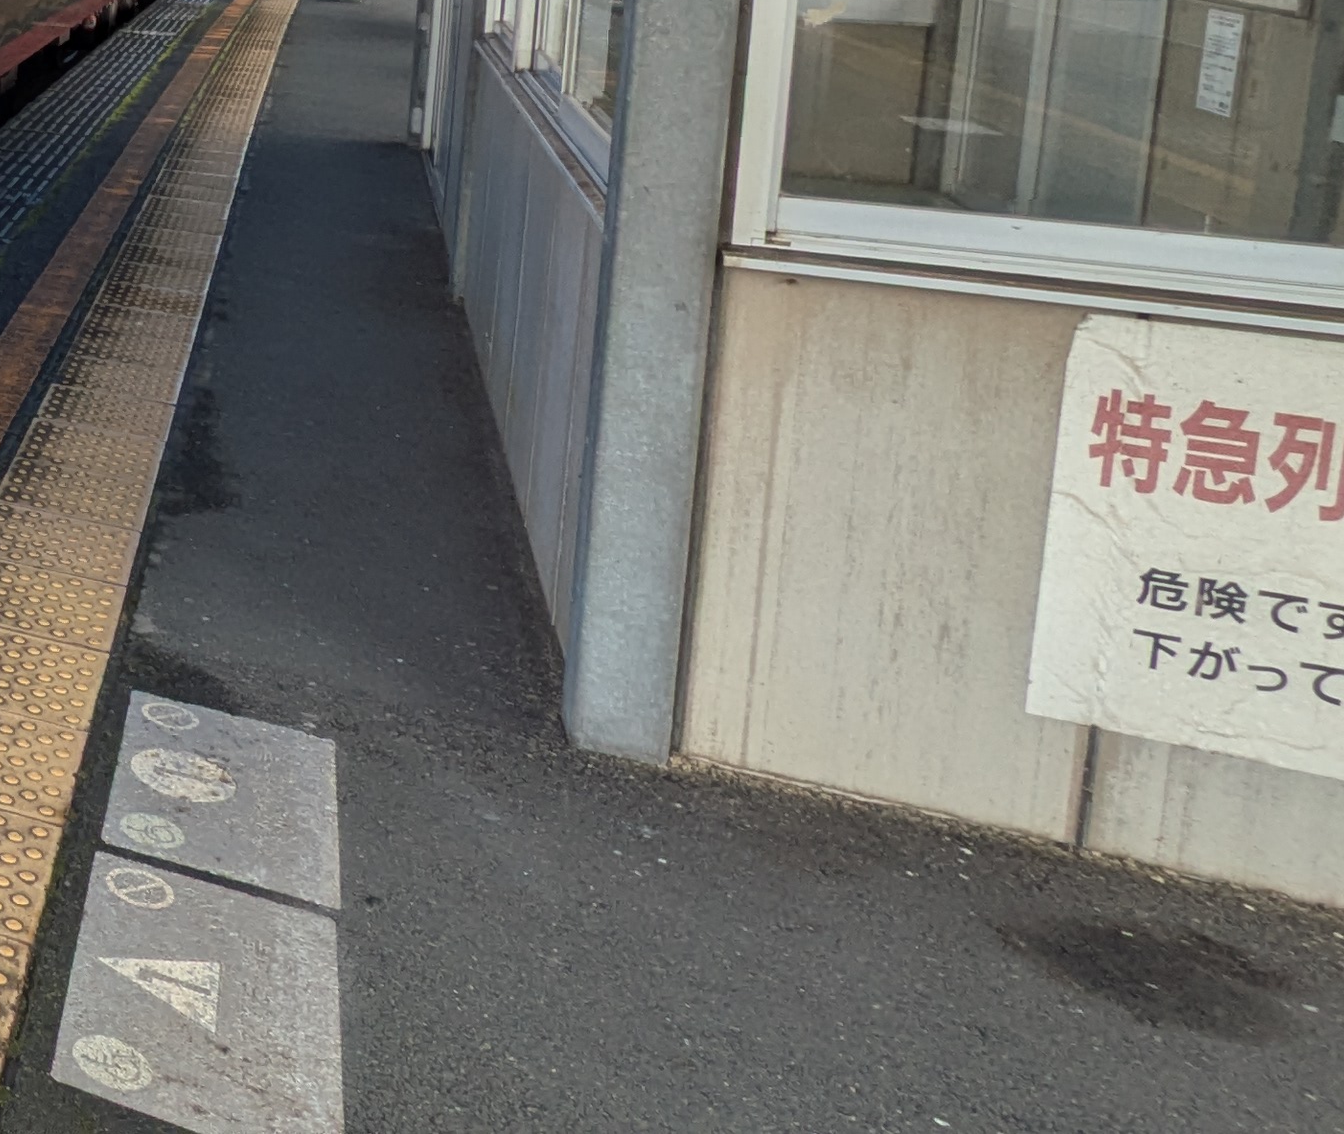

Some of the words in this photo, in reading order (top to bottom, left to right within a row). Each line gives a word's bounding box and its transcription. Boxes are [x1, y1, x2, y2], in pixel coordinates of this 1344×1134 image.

[1088, 388, 1344, 523] 特急列
[1132, 628, 1344, 708] 下がって
